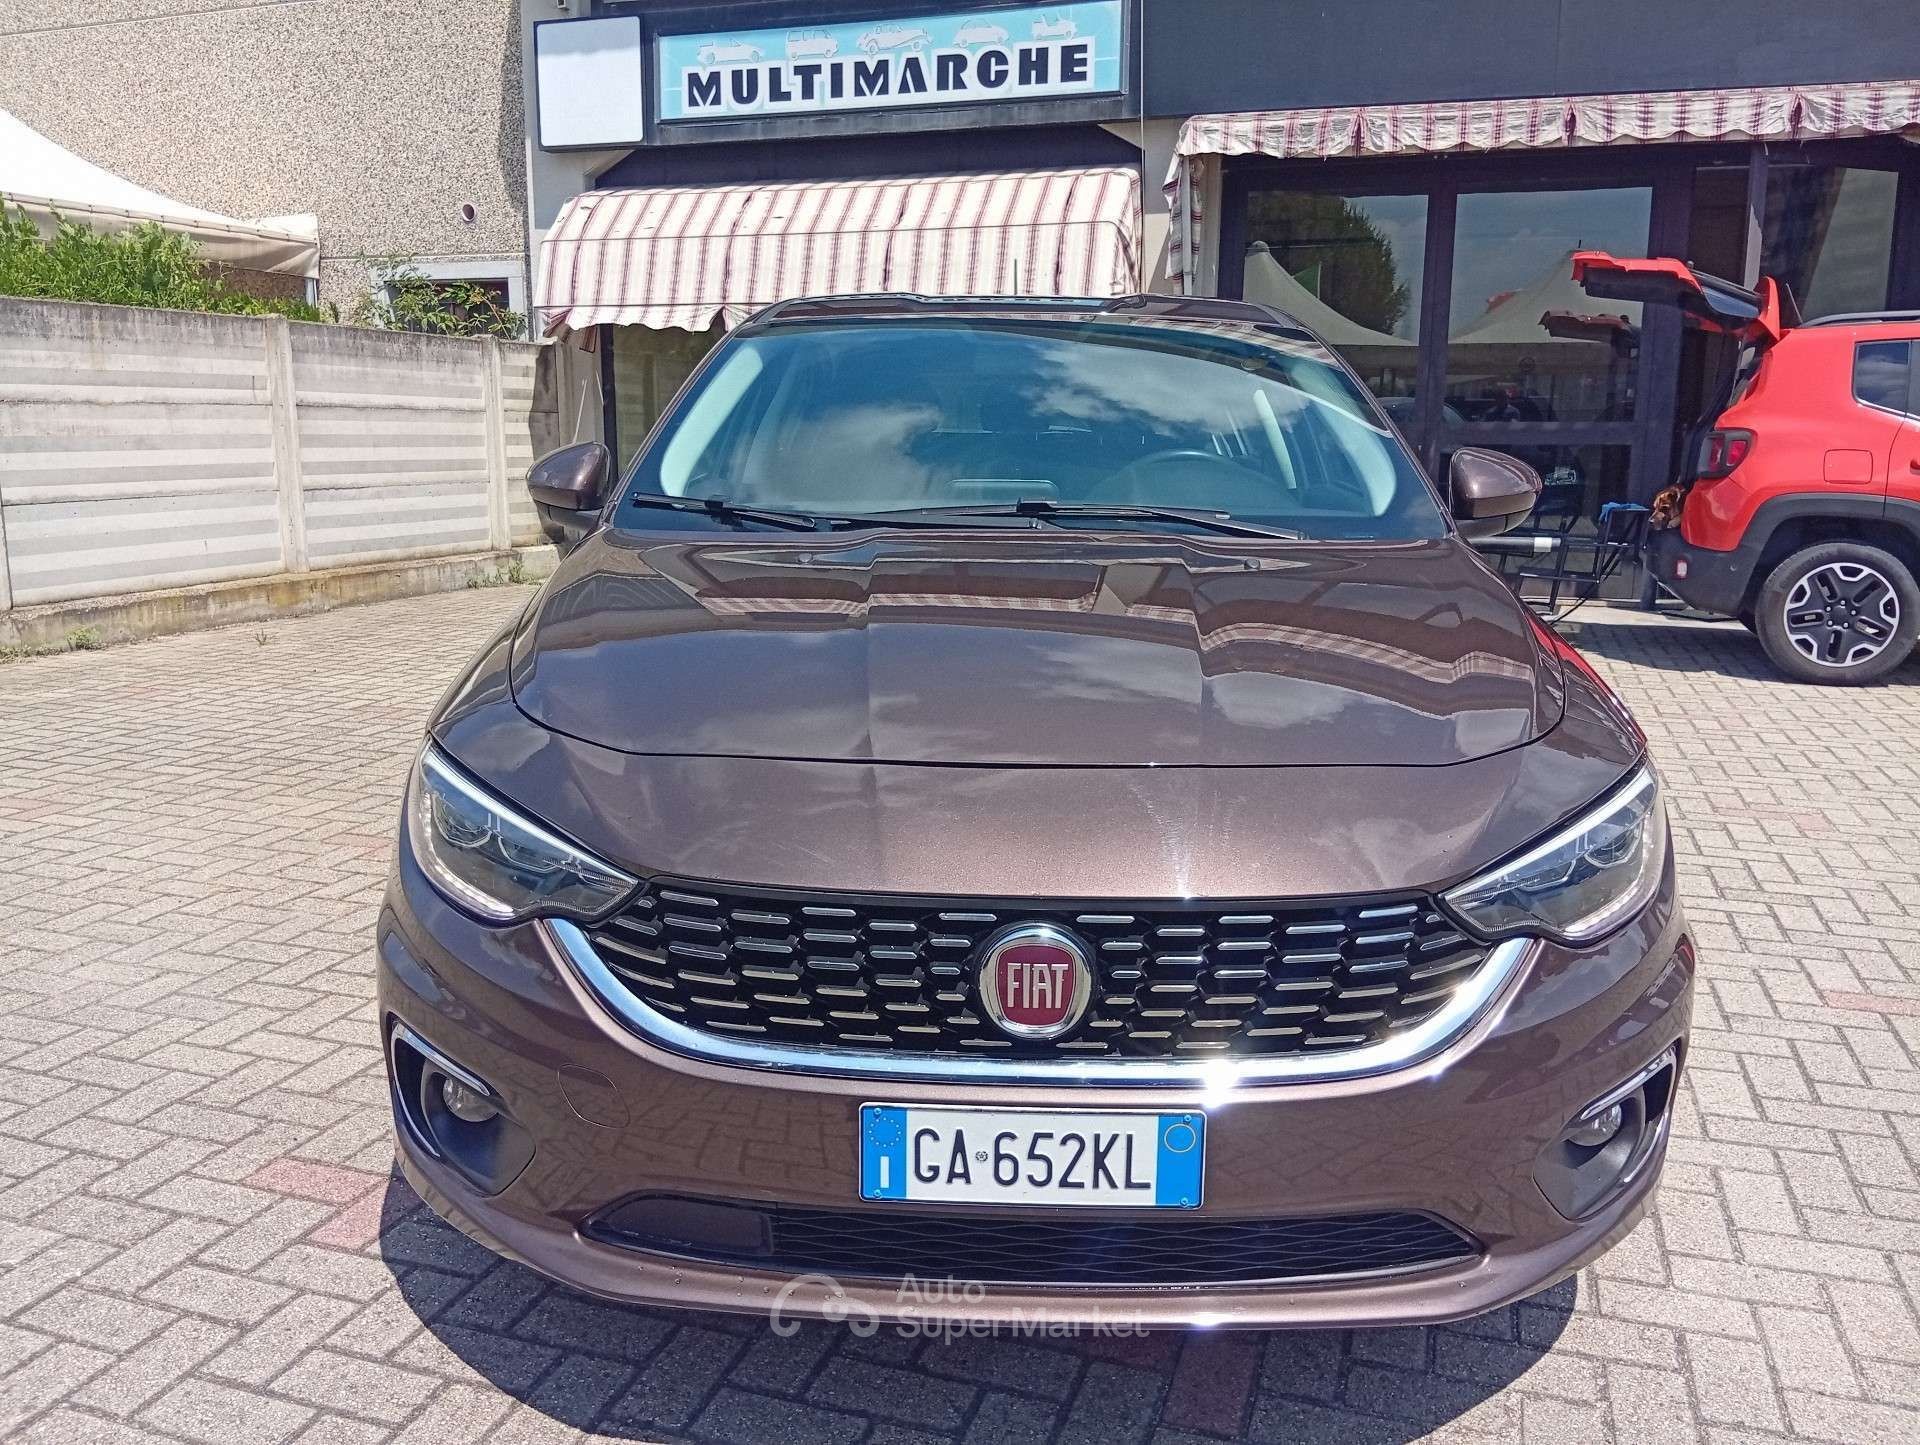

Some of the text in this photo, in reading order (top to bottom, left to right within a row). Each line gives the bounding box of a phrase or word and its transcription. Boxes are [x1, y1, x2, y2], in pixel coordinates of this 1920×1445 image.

[688, 44, 1088, 107] MULTIMARCHE
[1007, 962, 1069, 1009] FIAT
[914, 1127, 972, 1185] GA
[992, 1131, 1152, 1189] 652KL
